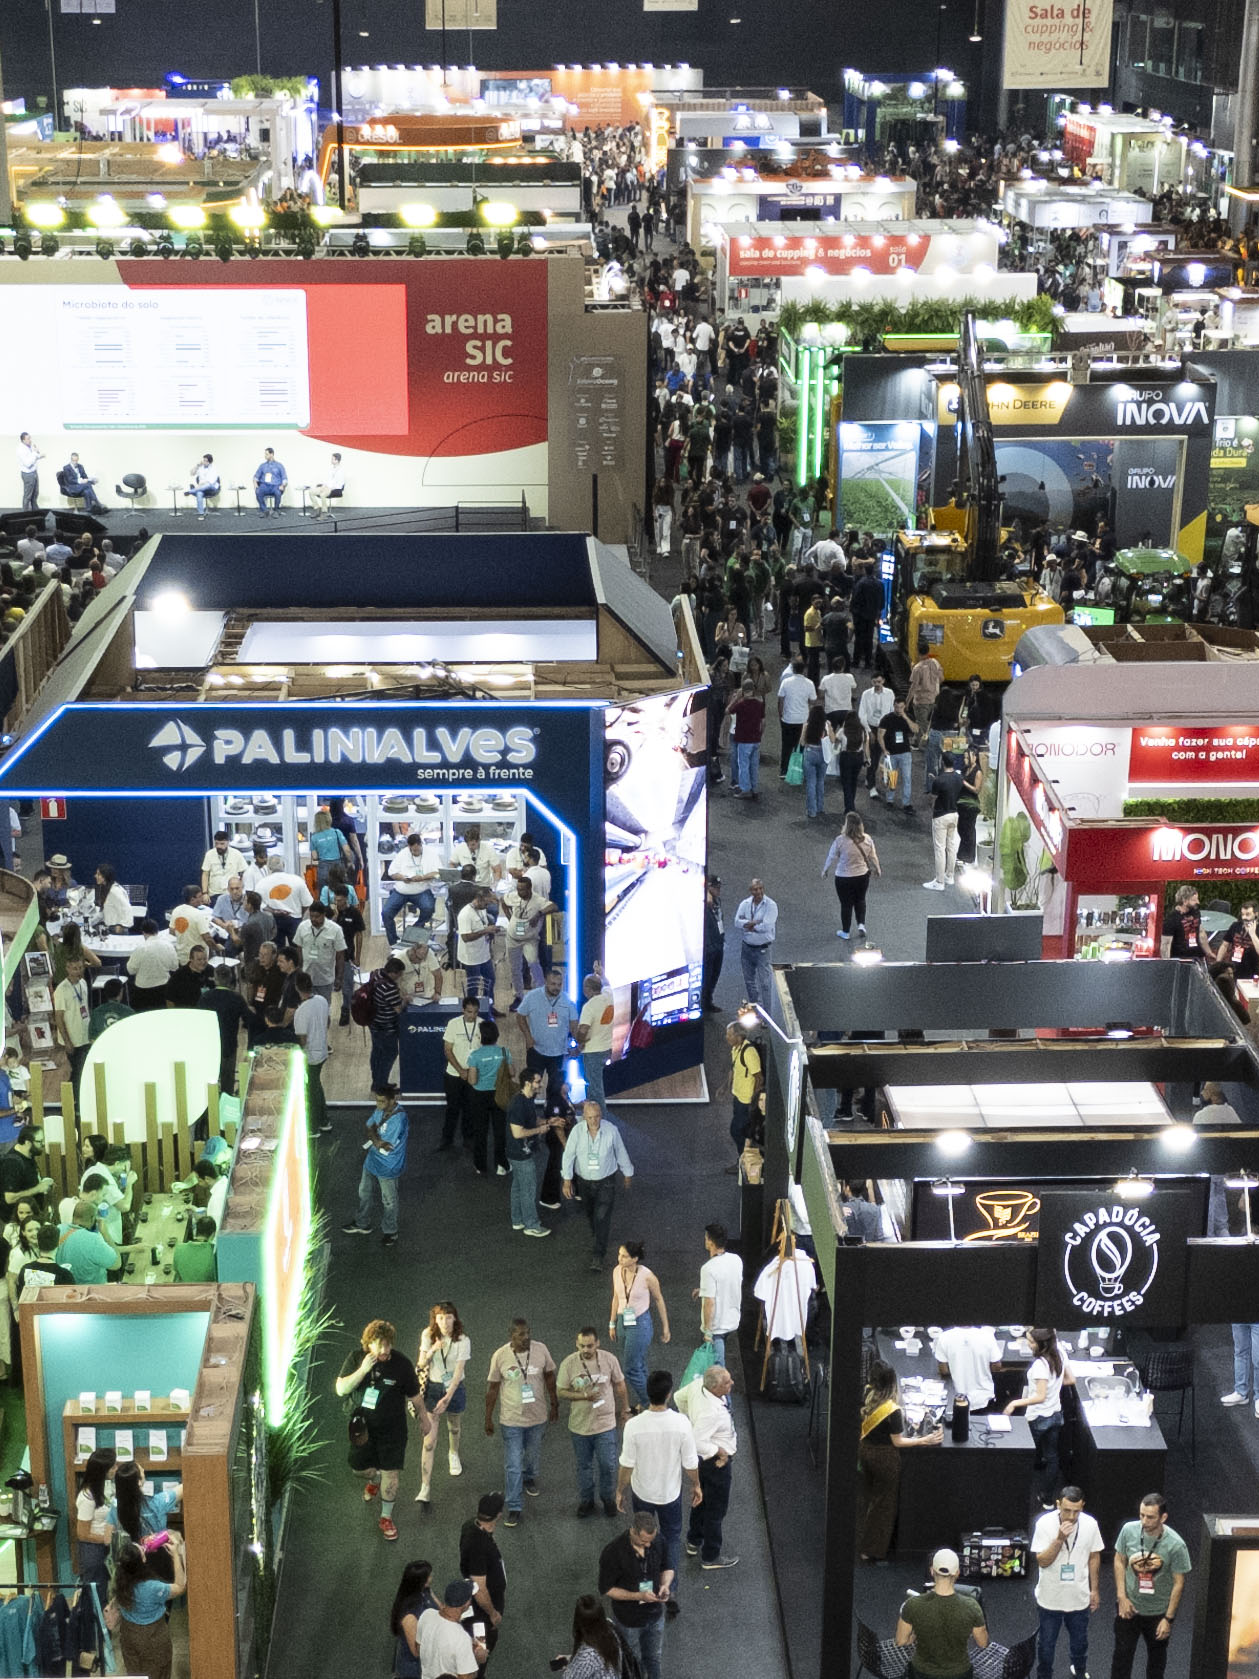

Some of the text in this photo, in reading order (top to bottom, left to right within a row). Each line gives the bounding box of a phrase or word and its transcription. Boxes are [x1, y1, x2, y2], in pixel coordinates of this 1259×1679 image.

[1029, 4, 1091, 19] Sala de
[1024, 21, 1093, 36] cupping &
[1028, 37, 1089, 54] negócios
[740, 246, 871, 260] sala de cupping & negócios
[889, 254, 906, 267] 01
[62, 300, 118, 309] Microbiota
[137, 300, 159, 309] solo
[425, 313, 512, 334] arena
[465, 340, 513, 365] SIC
[444, 368, 514, 383] arena sic
[1013, 399, 1056, 411] DEERE
[1117, 402, 1210, 425] INOVA
[1128, 467, 1155, 475] GRUPO
[1140, 736, 1175, 747] Venha
[1179, 736, 1209, 747] fazer
[1212, 737, 1234, 747] sua
[1171, 750, 1196, 760] com
[1198, 750, 1206, 760] a
[417, 766, 534, 781] sempre à frente
[1064, 1205, 1161, 1247] CAPADÓCIA
[1072, 1291, 1144, 1317] COFFEES
